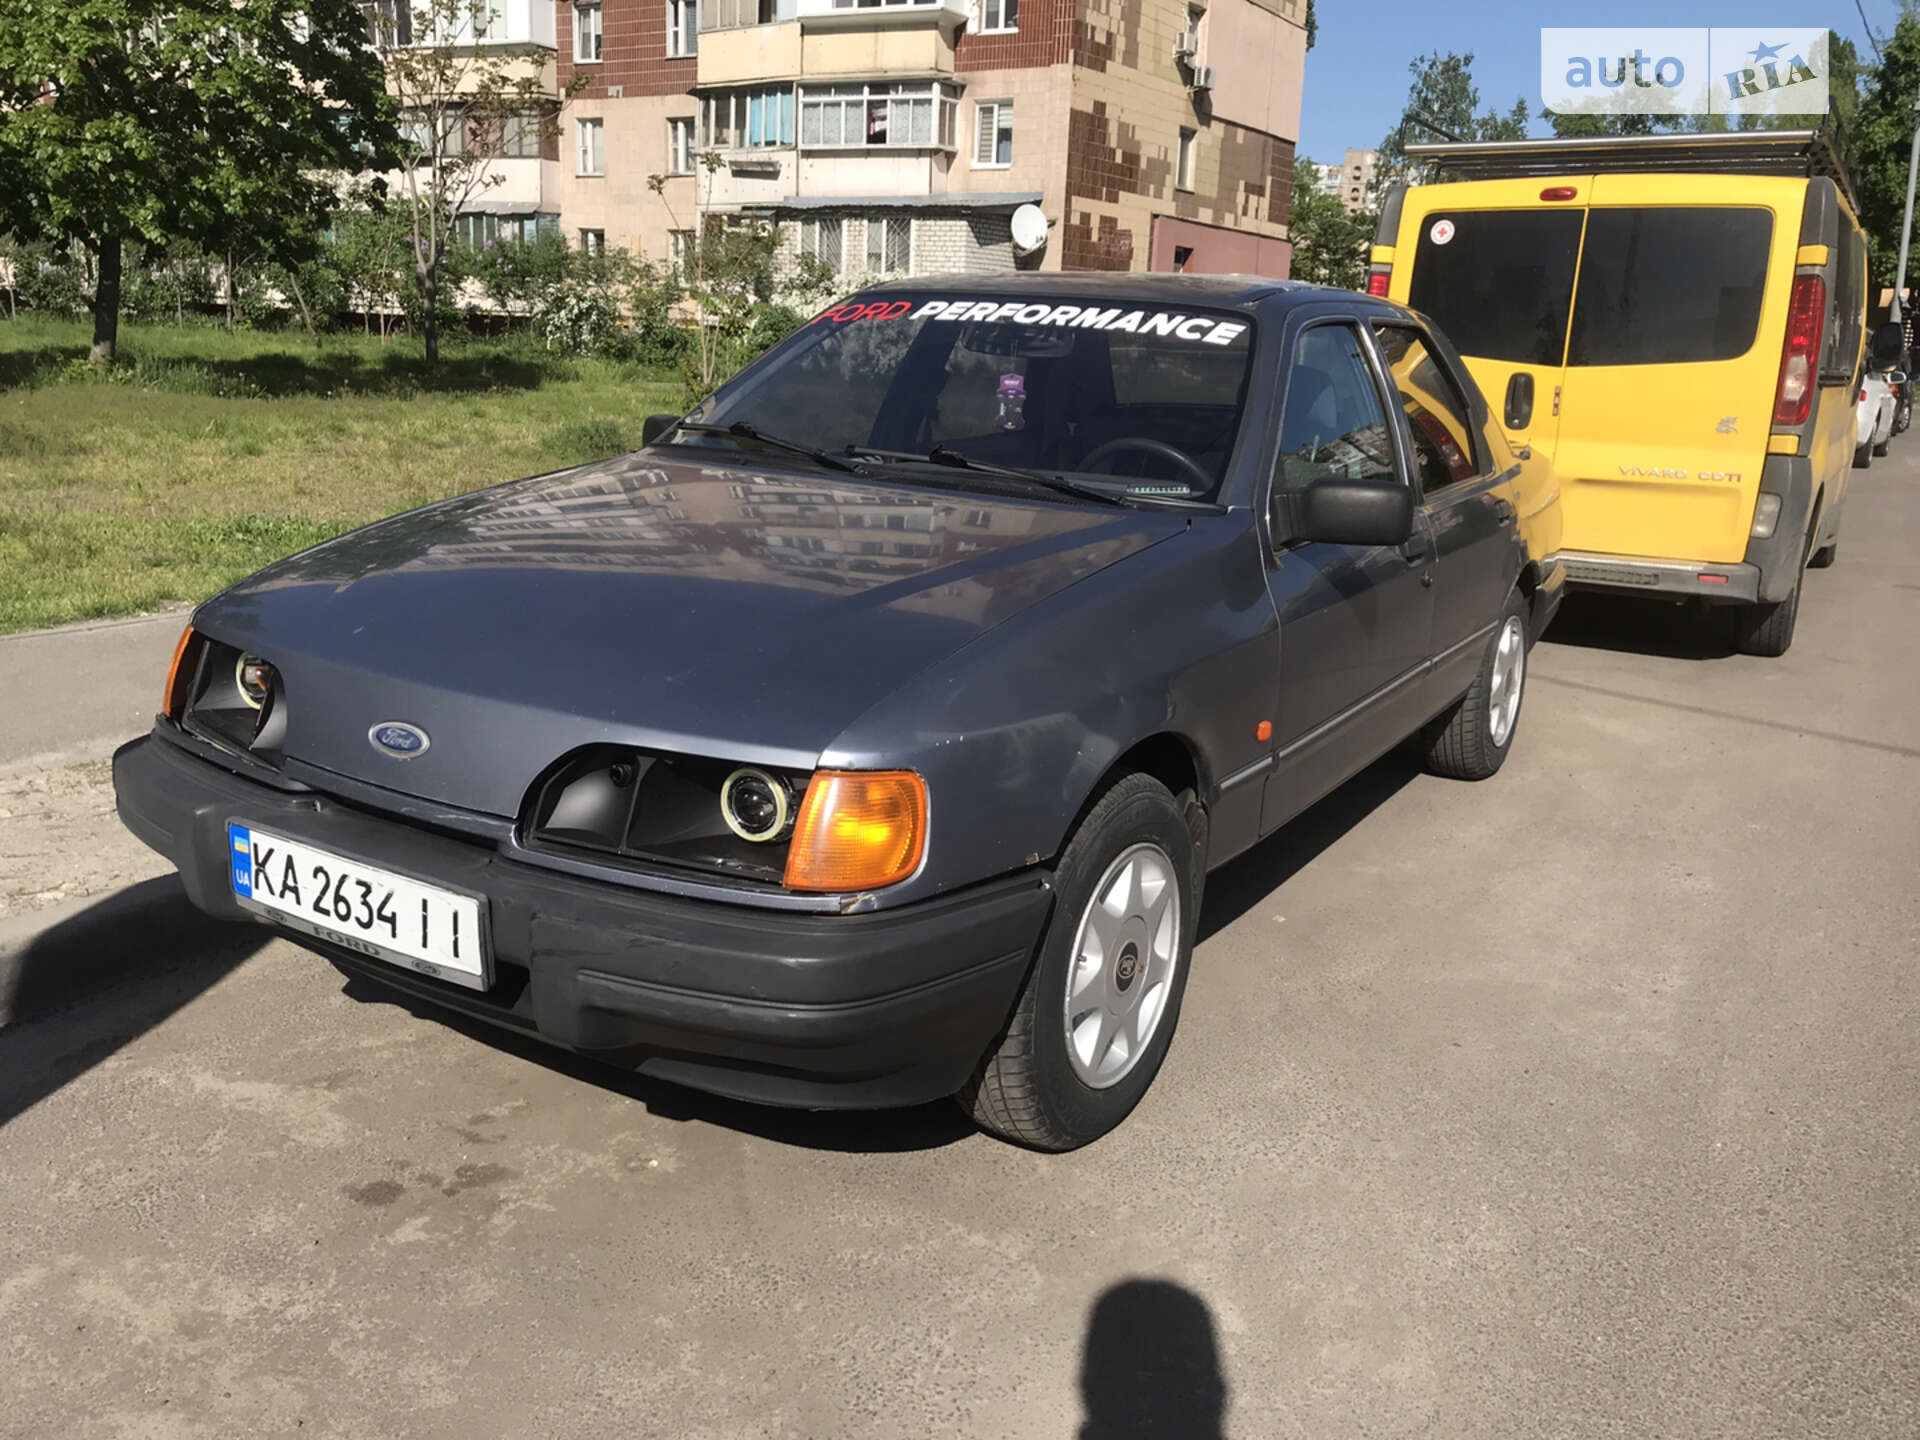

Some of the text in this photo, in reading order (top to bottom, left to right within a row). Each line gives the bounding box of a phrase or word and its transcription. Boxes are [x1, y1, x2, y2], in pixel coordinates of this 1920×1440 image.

[812, 301, 1246, 346] FORD PERFORMANCE
[1618, 465, 1742, 483] VIVARO CDTI
[235, 870, 250, 886] UA
[313, 926, 381, 956] FORD
